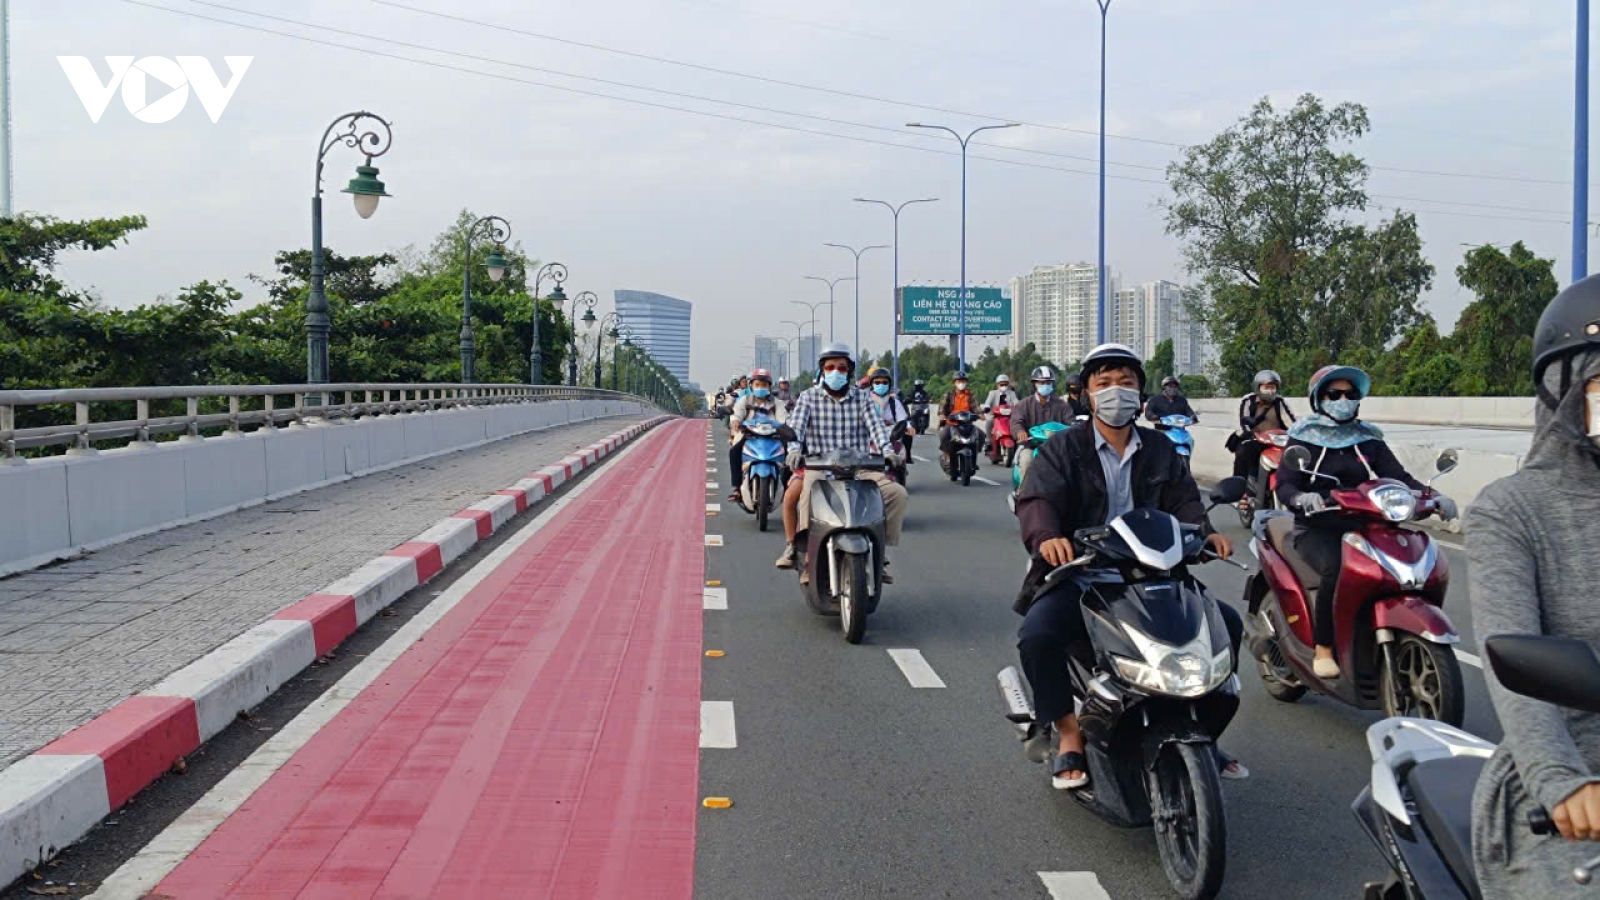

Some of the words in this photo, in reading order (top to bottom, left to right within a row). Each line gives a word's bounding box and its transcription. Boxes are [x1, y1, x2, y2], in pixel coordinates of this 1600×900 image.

[938, 290, 956, 298] NSG
[913, 299, 932, 308] LIÊN
[935, 299, 947, 309] HỆ
[983, 299, 1002, 308] CÁO
